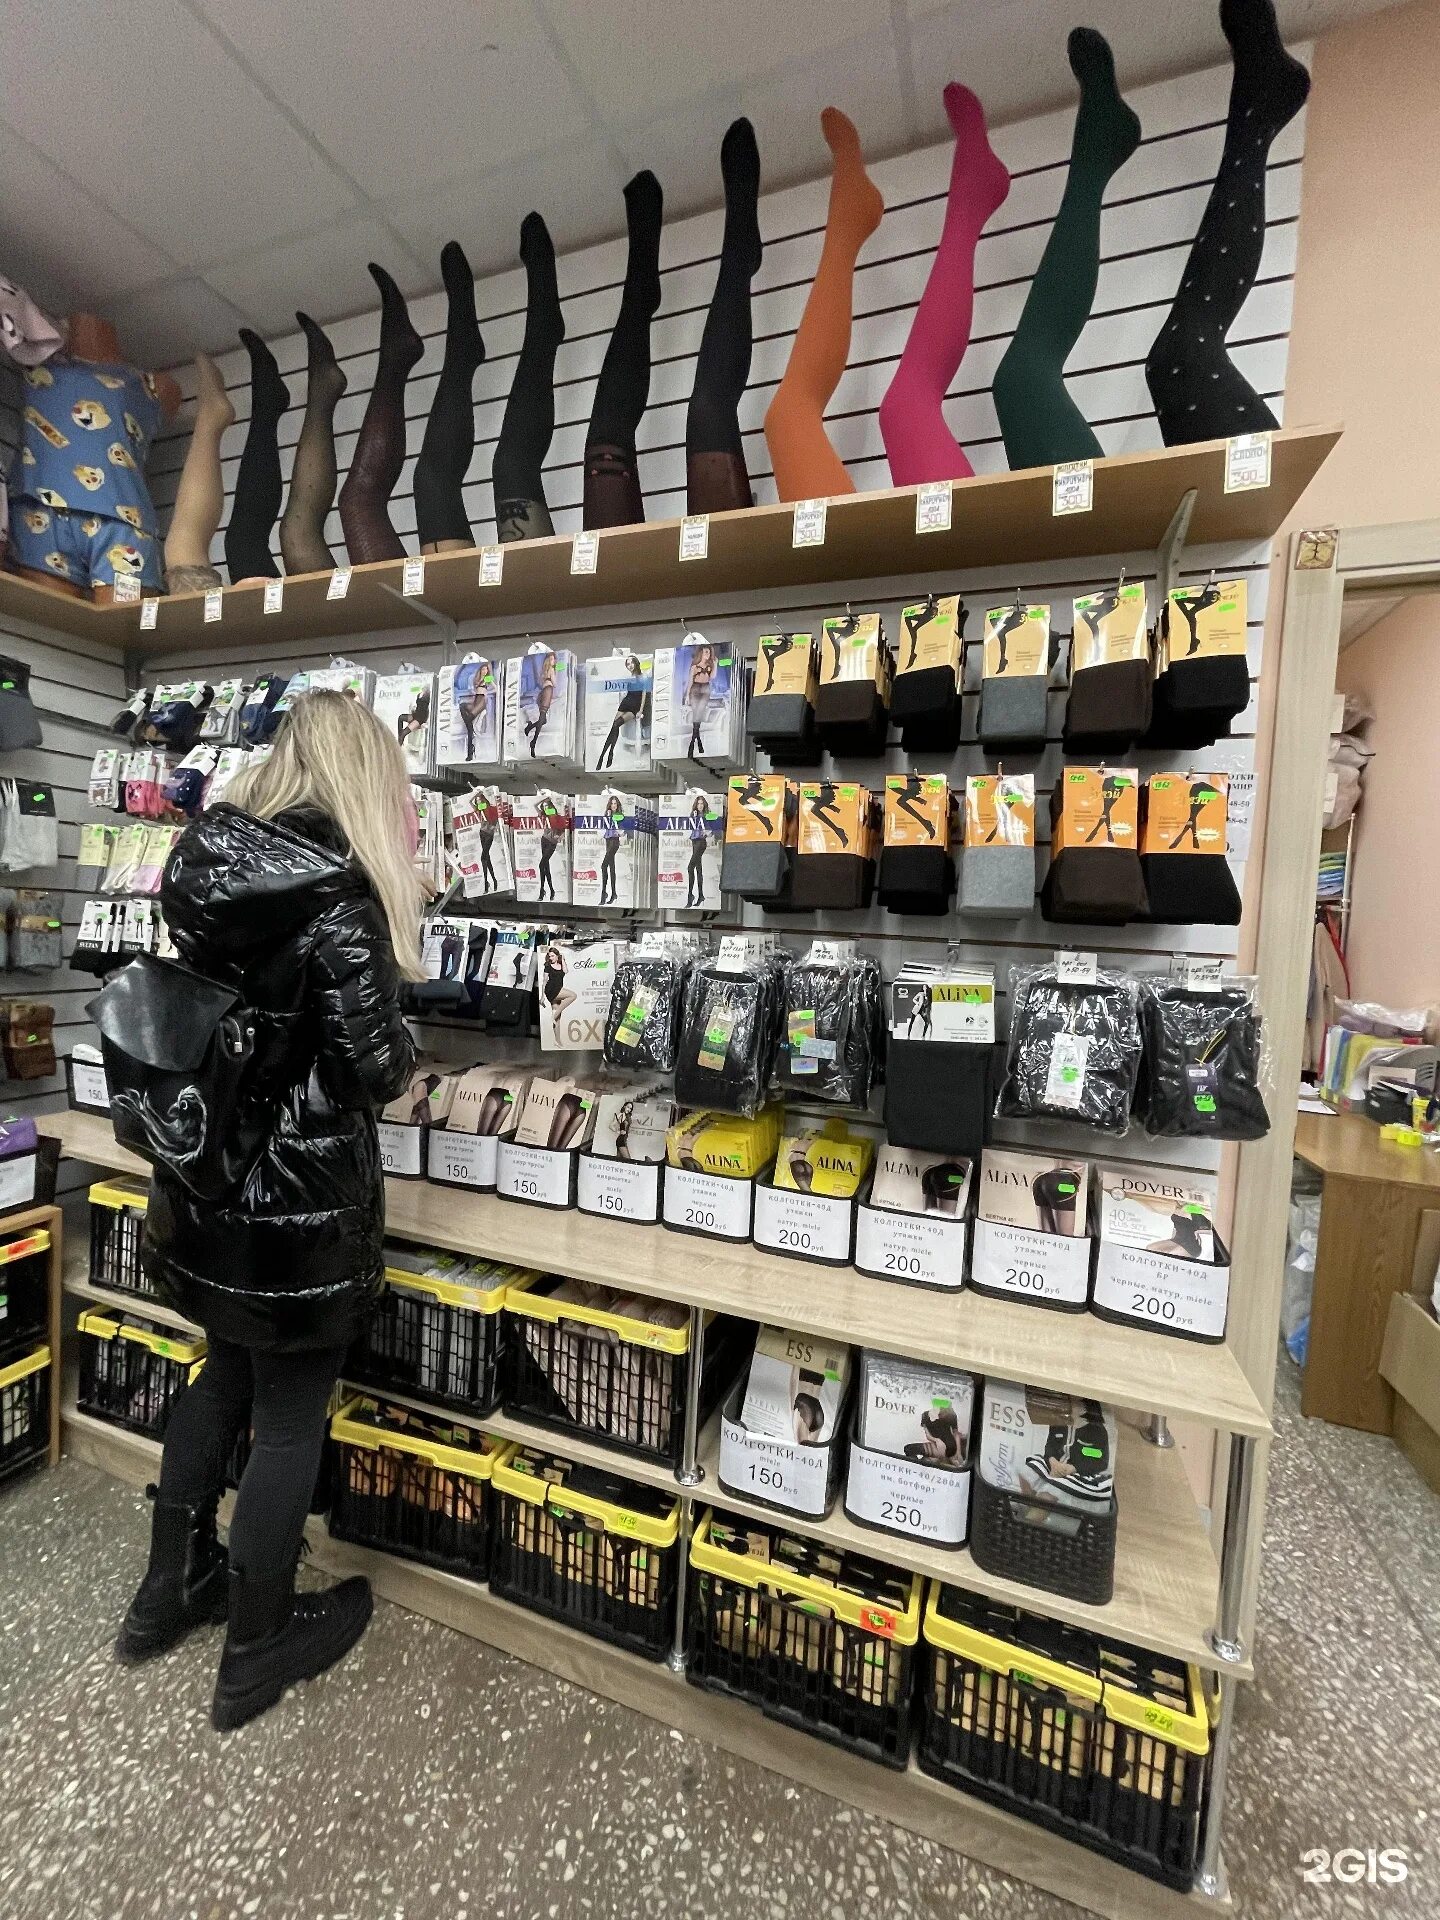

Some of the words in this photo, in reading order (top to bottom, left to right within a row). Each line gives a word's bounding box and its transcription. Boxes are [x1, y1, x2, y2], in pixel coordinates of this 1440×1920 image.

[567, 1018, 607, 1043] 6X
[446, 1164, 468, 1179] 150
[513, 1178, 537, 1196] 150
[1121, 1178, 1184, 1199] DOVER
[597, 1194, 623, 1211] 150
[768, 1195, 832, 1213] КОЛГОТКИ-40Д
[685, 1208, 715, 1227] 200
[1109, 1208, 1126, 1222] 40
[873, 1217, 945, 1236] КОЛГОТКИ-40Д
[778, 1229, 811, 1249] 200
[811, 1245, 824, 1253] руб
[994, 1230, 1071, 1251] КОЛГОТКИ-40Д
[885, 1253, 921, 1274] 200
[921, 1270, 936, 1278] руб
[1121, 1253, 1208, 1280] КОЛГОТКИ-40Д
[1005, 1268, 1044, 1290] 200
[1044, 1286, 1060, 1295] руб
[1131, 1293, 1176, 1320] 200
[1175, 1315, 1193, 1326] руб
[1186, 1294, 1213, 1307] miele
[785, 1339, 814, 1363] ESS
[874, 1396, 916, 1415] DOVER
[990, 1401, 1026, 1428] ESS
[723, 1427, 823, 1469] КОЛГОТКИ-40Д
[748, 1464, 783, 1490] 150
[783, 1486, 799, 1496] руб
[898, 1477, 936, 1494] ботфорт
[890, 1491, 924, 1505] черные
[880, 1501, 922, 1527] 250
[922, 1523, 938, 1533] руб
